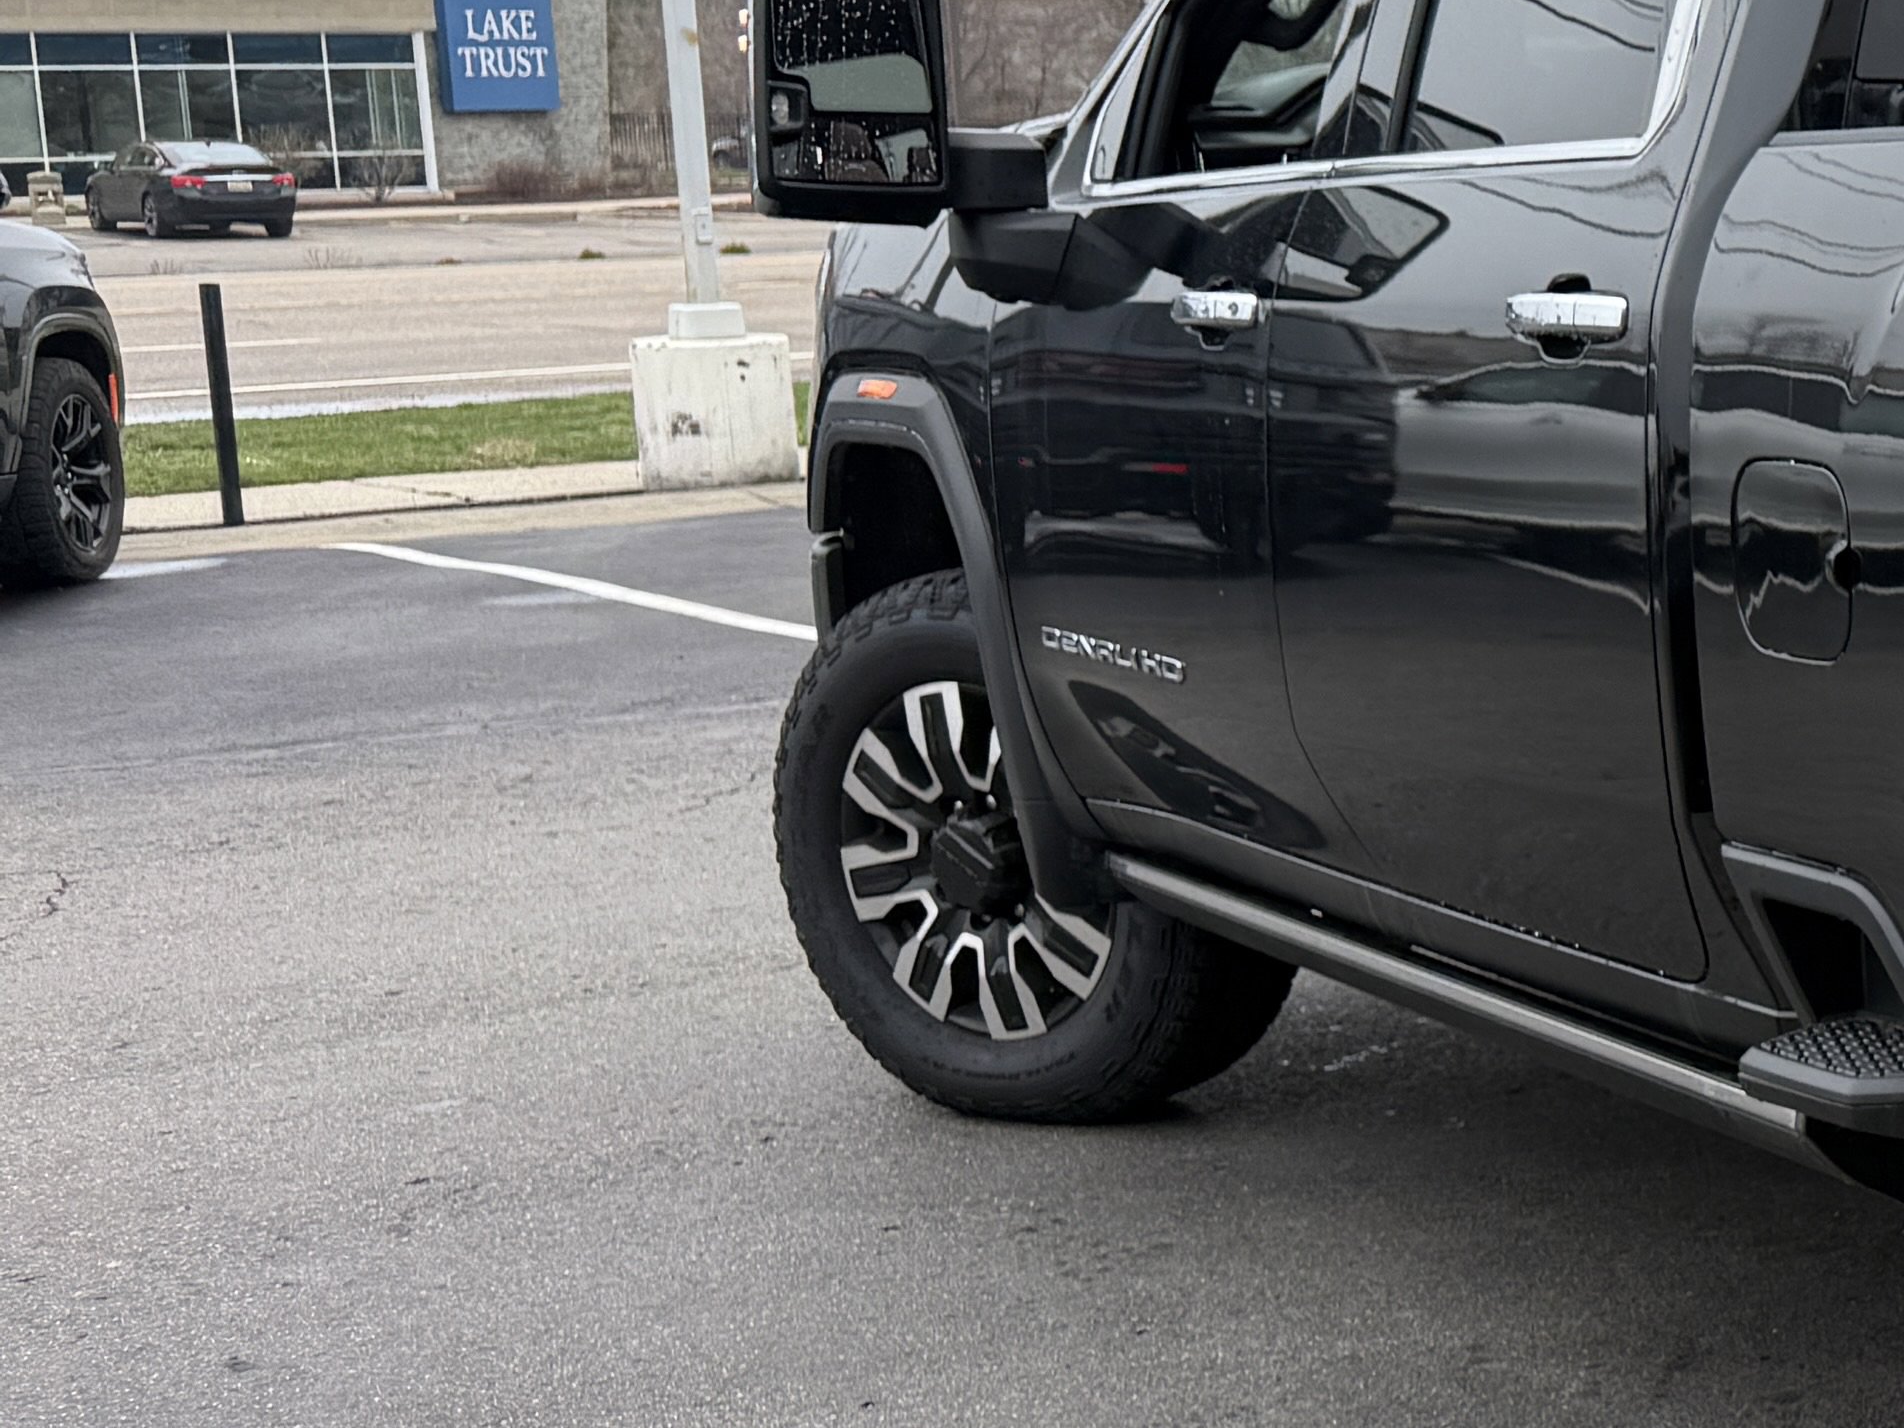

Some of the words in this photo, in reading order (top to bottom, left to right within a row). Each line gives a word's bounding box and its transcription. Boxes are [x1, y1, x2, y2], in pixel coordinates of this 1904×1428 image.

[464, 8, 537, 42] LAKE
[457, 45, 549, 78] TRUST
[1041, 625, 1138, 671] DENALI
[1141, 649, 1184, 683] HD
